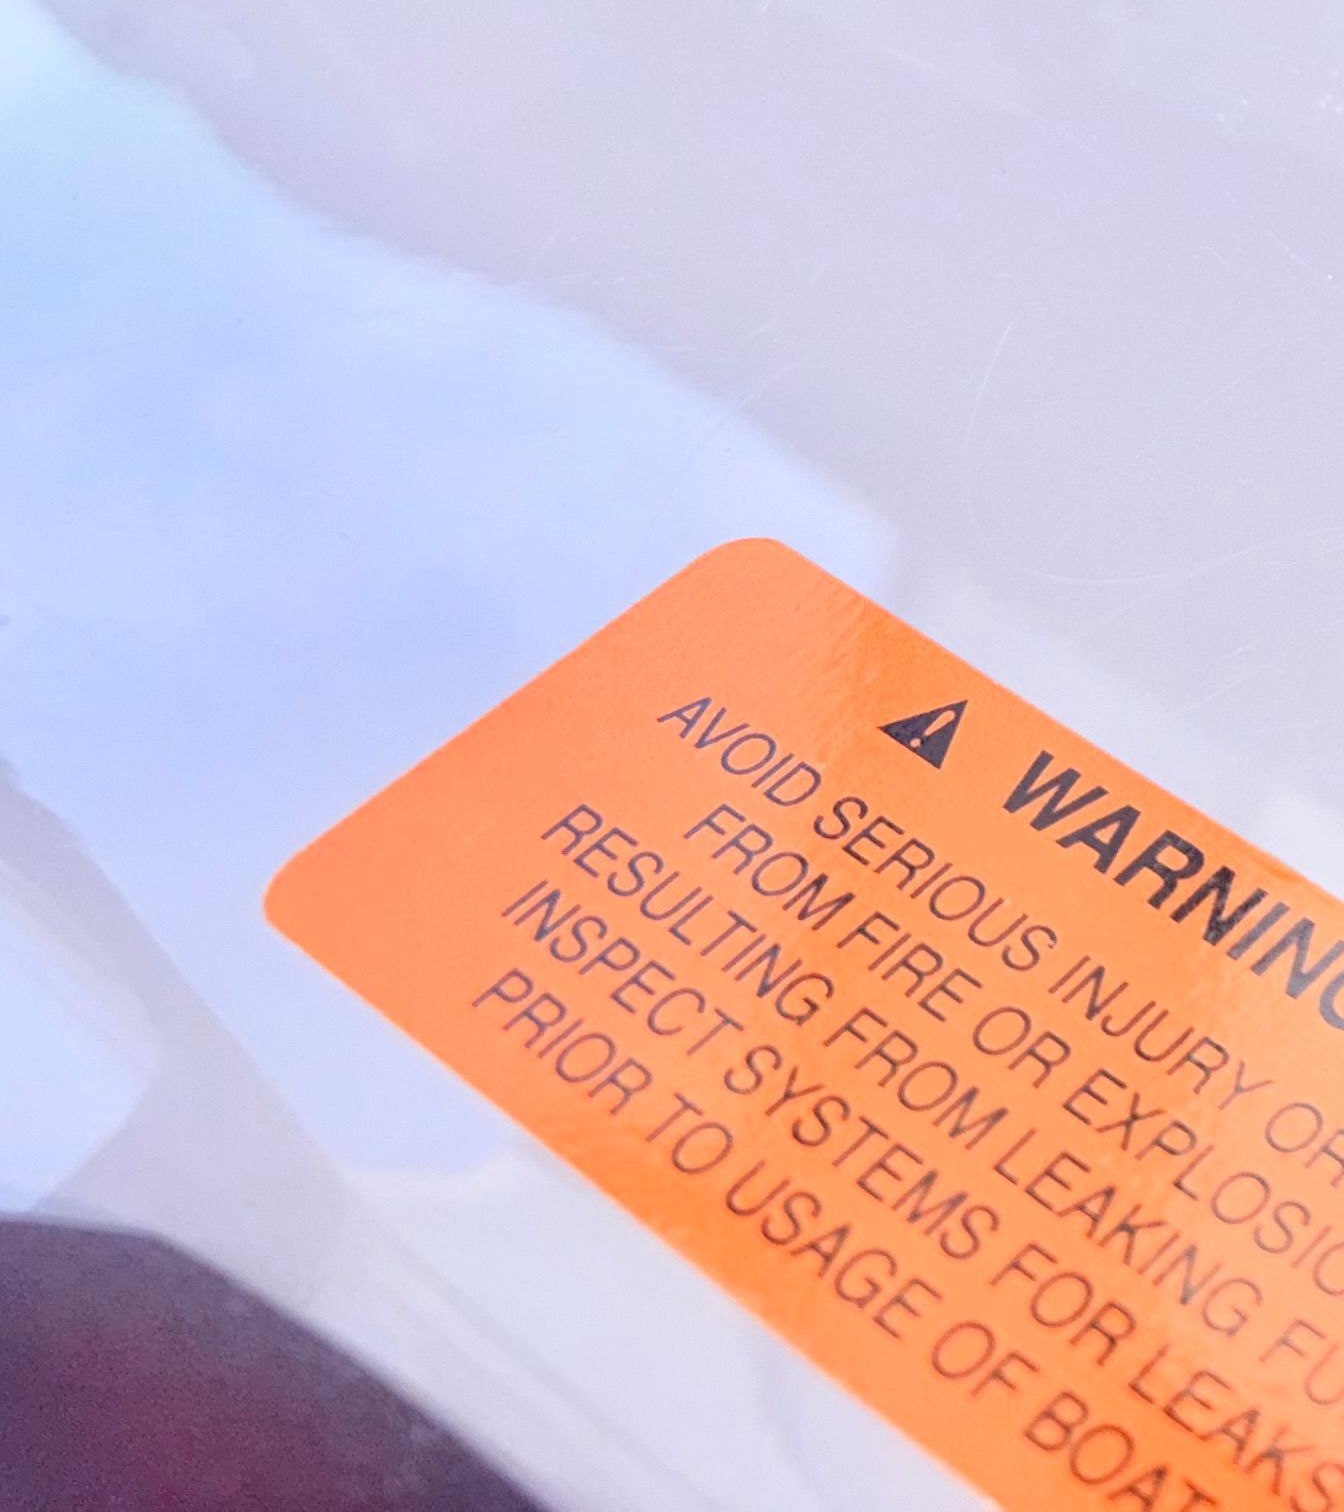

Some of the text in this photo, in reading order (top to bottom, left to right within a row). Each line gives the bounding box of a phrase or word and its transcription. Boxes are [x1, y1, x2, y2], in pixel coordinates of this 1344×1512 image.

[543, 803, 836, 1027] RESULTING
[823, 1007, 1007, 1151] FROM
[994, 1127, 1261, 1336] LEAKING
[657, 696, 822, 808] AVOID
[813, 797, 1057, 973] SERIOUS
[1051, 955, 1273, 1104] INJURY
[684, 804, 855, 930] FROM
[836, 915, 982, 1023] FIRE
[971, 1007, 1072, 1087] OR
[472, 969, 653, 1116] PRIOR
[645, 1092, 735, 1177] TO
[724, 1162, 941, 1341] USAGE
[931, 1321, 1040, 1397] OF
[501, 879, 741, 1055] INSPECT
[724, 1045, 1000, 1261] SYSTEMS
[990, 1243, 1136, 1367] FOR
